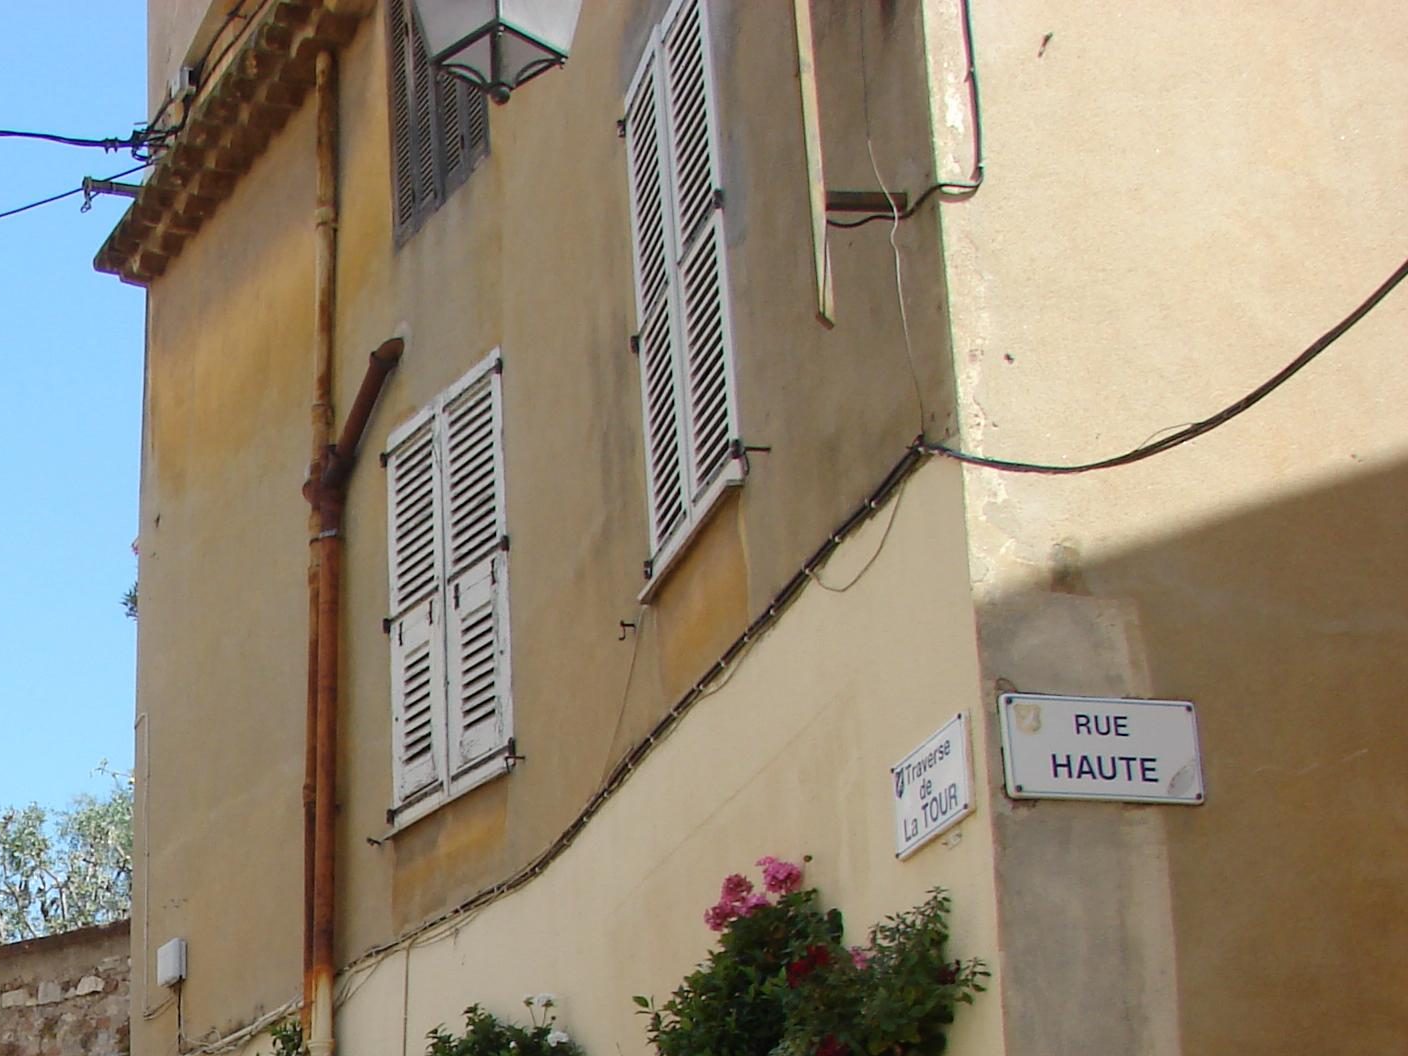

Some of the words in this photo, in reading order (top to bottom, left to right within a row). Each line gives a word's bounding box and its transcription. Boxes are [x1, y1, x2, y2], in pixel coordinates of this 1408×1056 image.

[1075, 714, 1130, 737] RUE
[904, 740, 952, 785] Traverse
[1051, 754, 1159, 783] HAUTE
[919, 778, 933, 800] de
[903, 818, 919, 842] La
[921, 783, 959, 828] TOUR
